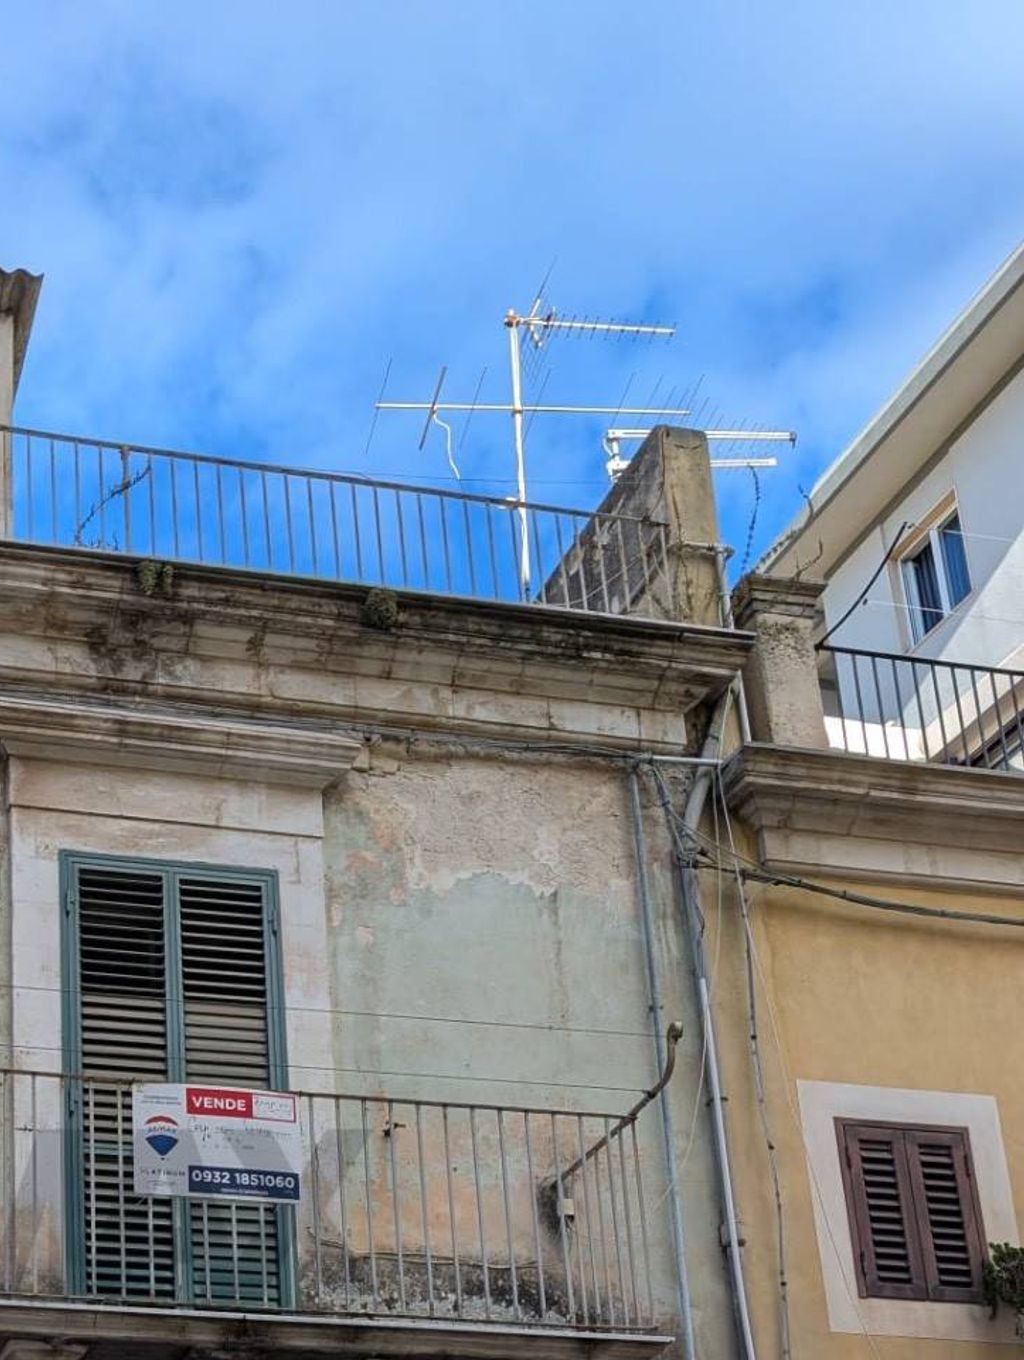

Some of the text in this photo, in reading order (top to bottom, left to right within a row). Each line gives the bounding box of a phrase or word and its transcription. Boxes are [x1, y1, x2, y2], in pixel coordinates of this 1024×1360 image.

[191, 1095, 247, 1111] VENDE
[191, 1169, 231, 1184] 0932
[234, 1172, 295, 1189] 1851060
